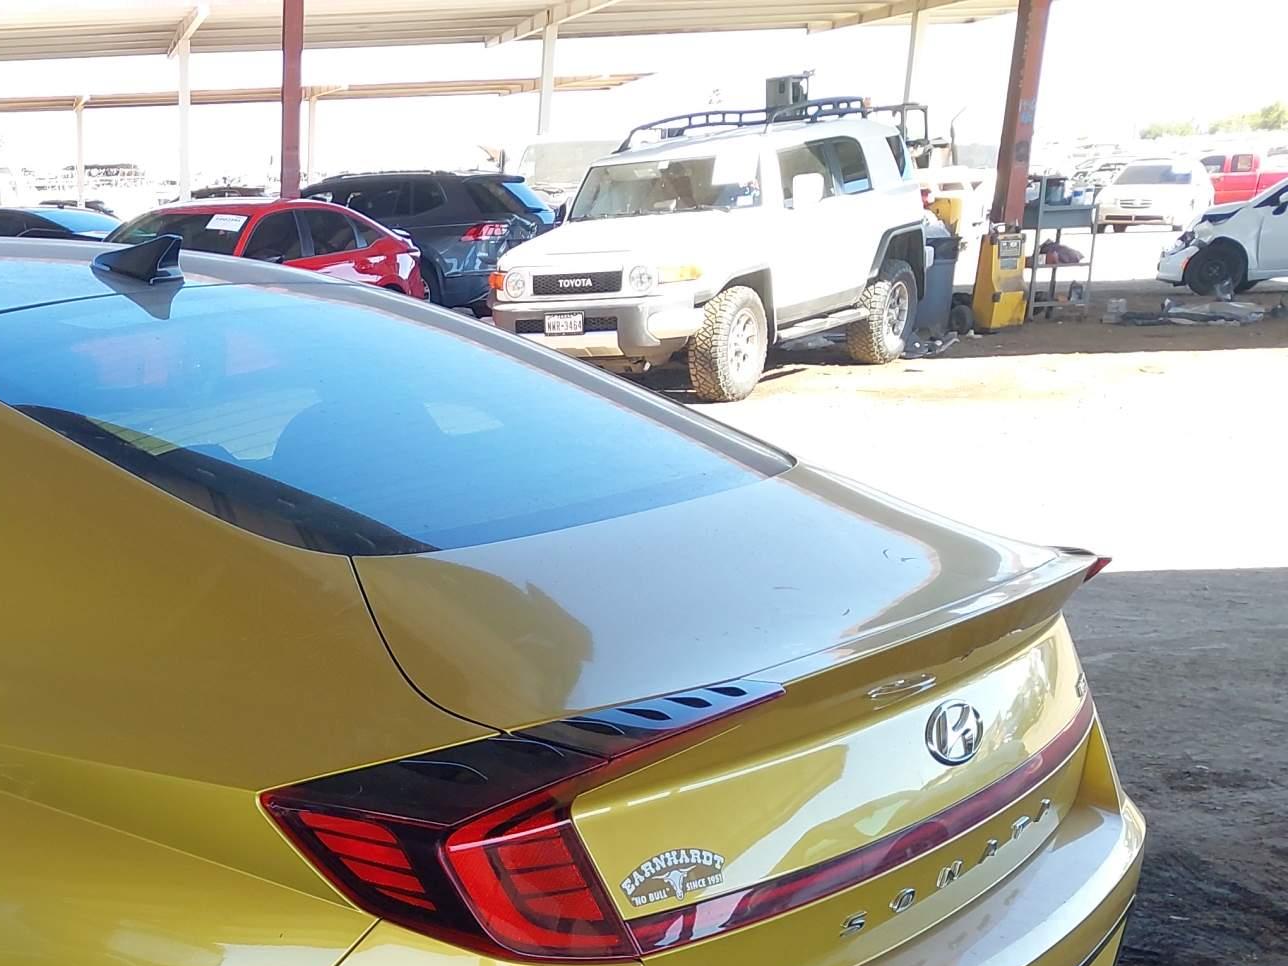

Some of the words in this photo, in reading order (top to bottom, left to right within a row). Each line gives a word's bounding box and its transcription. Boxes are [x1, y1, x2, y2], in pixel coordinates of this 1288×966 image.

[558, 278, 593, 288] TOYOTA
[621, 849, 724, 896] EARNHARDT
[839, 799, 1051, 938] SONATA
[686, 878, 706, 891] SINCE
